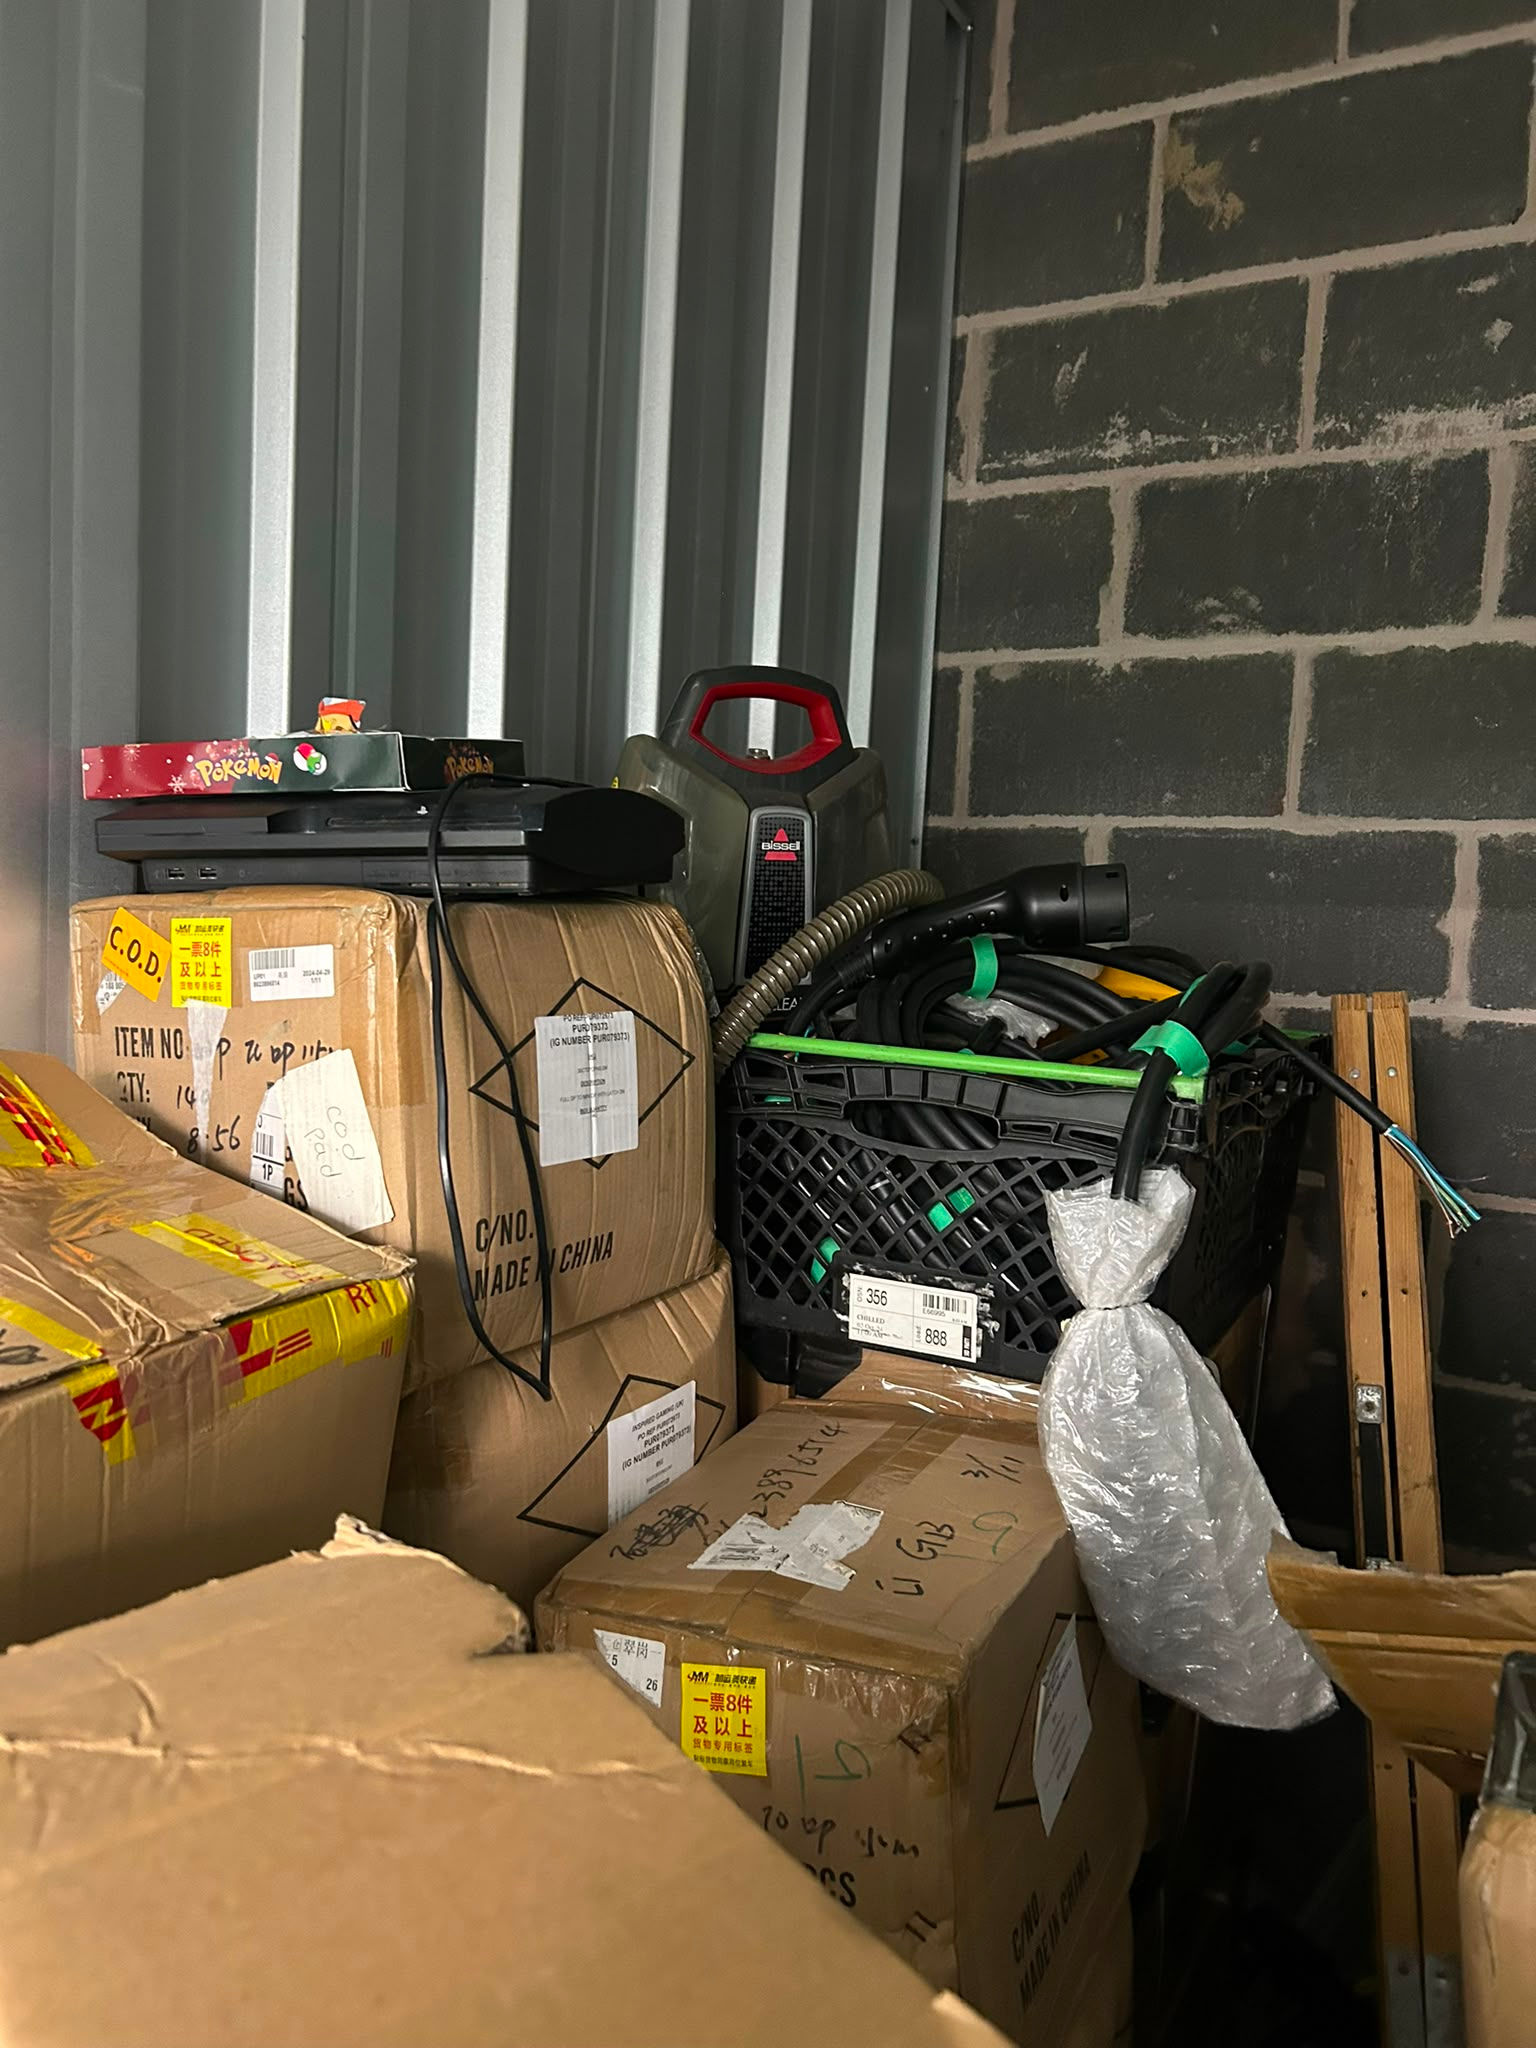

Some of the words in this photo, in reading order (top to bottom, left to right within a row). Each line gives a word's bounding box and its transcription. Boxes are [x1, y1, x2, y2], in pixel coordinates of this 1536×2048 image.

[110, 926, 162, 983] C.O.D.
[179, 941, 221, 958] 一票8件
[180, 962, 222, 978] 及以上
[114, 1026, 155, 1058] ITEM
[550, 1037, 561, 1049] (IG
[562, 1034, 592, 1046] NUMBER
[262, 1163, 274, 1181] 1P
[475, 1208, 534, 1253] C/NO.
[474, 1256, 532, 1301] MADE
[559, 1231, 614, 1273] CHINA
[866, 1287, 888, 1306] 356
[856, 1314, 886, 1325] CHILLED
[925, 1328, 948, 1347] 888
[632, 1415, 656, 1432] INSPIRED
[656, 1404, 674, 1420] GAMING
[637, 1432, 646, 1441] PO
[646, 1426, 656, 1437] REF
[622, 1458, 632, 1471] (IG
[633, 1443, 661, 1463] NUMBER
[646, 1678, 658, 1692] 26
[693, 1692, 753, 1714] 一票8件
[693, 1715, 753, 1738] 及以上
[693, 1738, 753, 1754] 货物专用标签
[803, 1862, 856, 1907] CS
[1020, 1931, 1051, 2013] MADE
[1049, 1912, 1061, 1950] IN
[1060, 1850, 1091, 1925] CHINA
